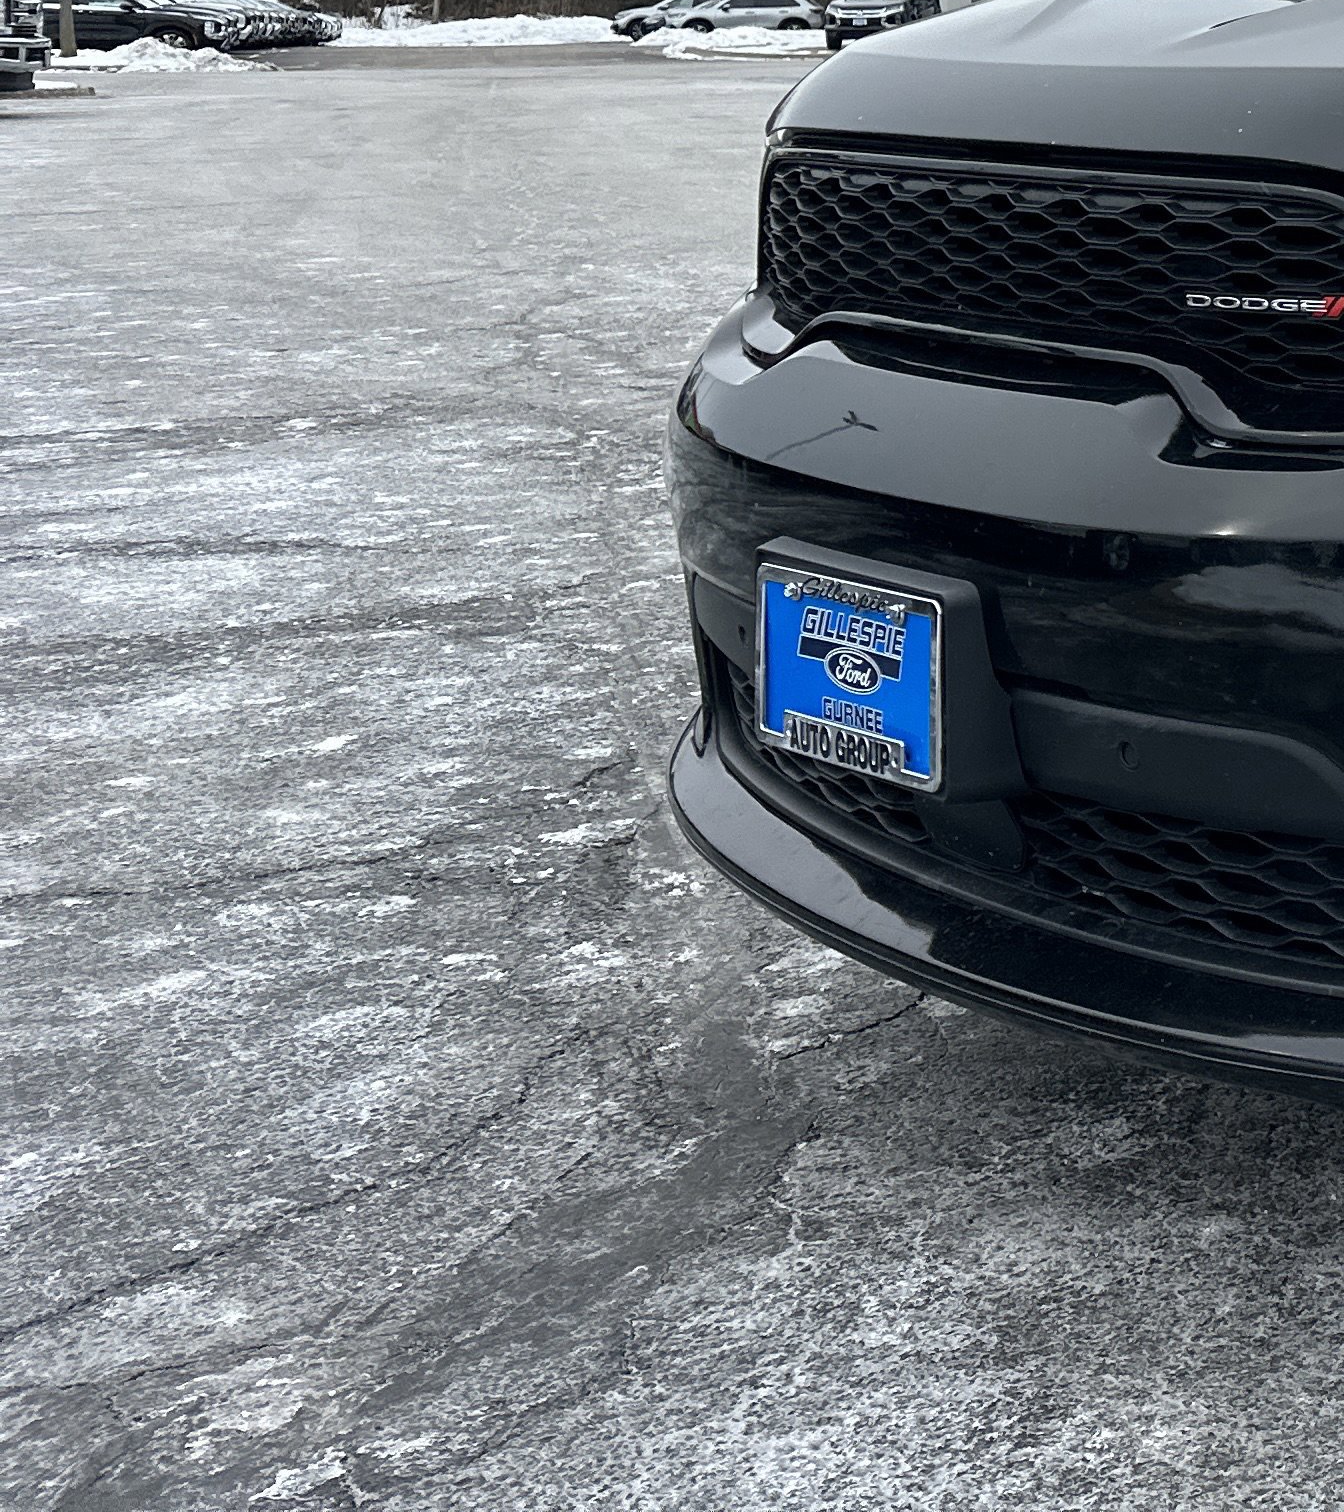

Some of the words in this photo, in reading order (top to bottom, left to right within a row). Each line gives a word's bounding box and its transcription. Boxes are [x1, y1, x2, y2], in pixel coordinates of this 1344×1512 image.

[1185, 293, 1328, 313] DODGE
[801, 606, 906, 658] GILLESPIE
[835, 654, 872, 688] Ford
[822, 696, 883, 735] GURNEE
[790, 718, 831, 759] AUTO
[835, 729, 891, 775] GROUP
